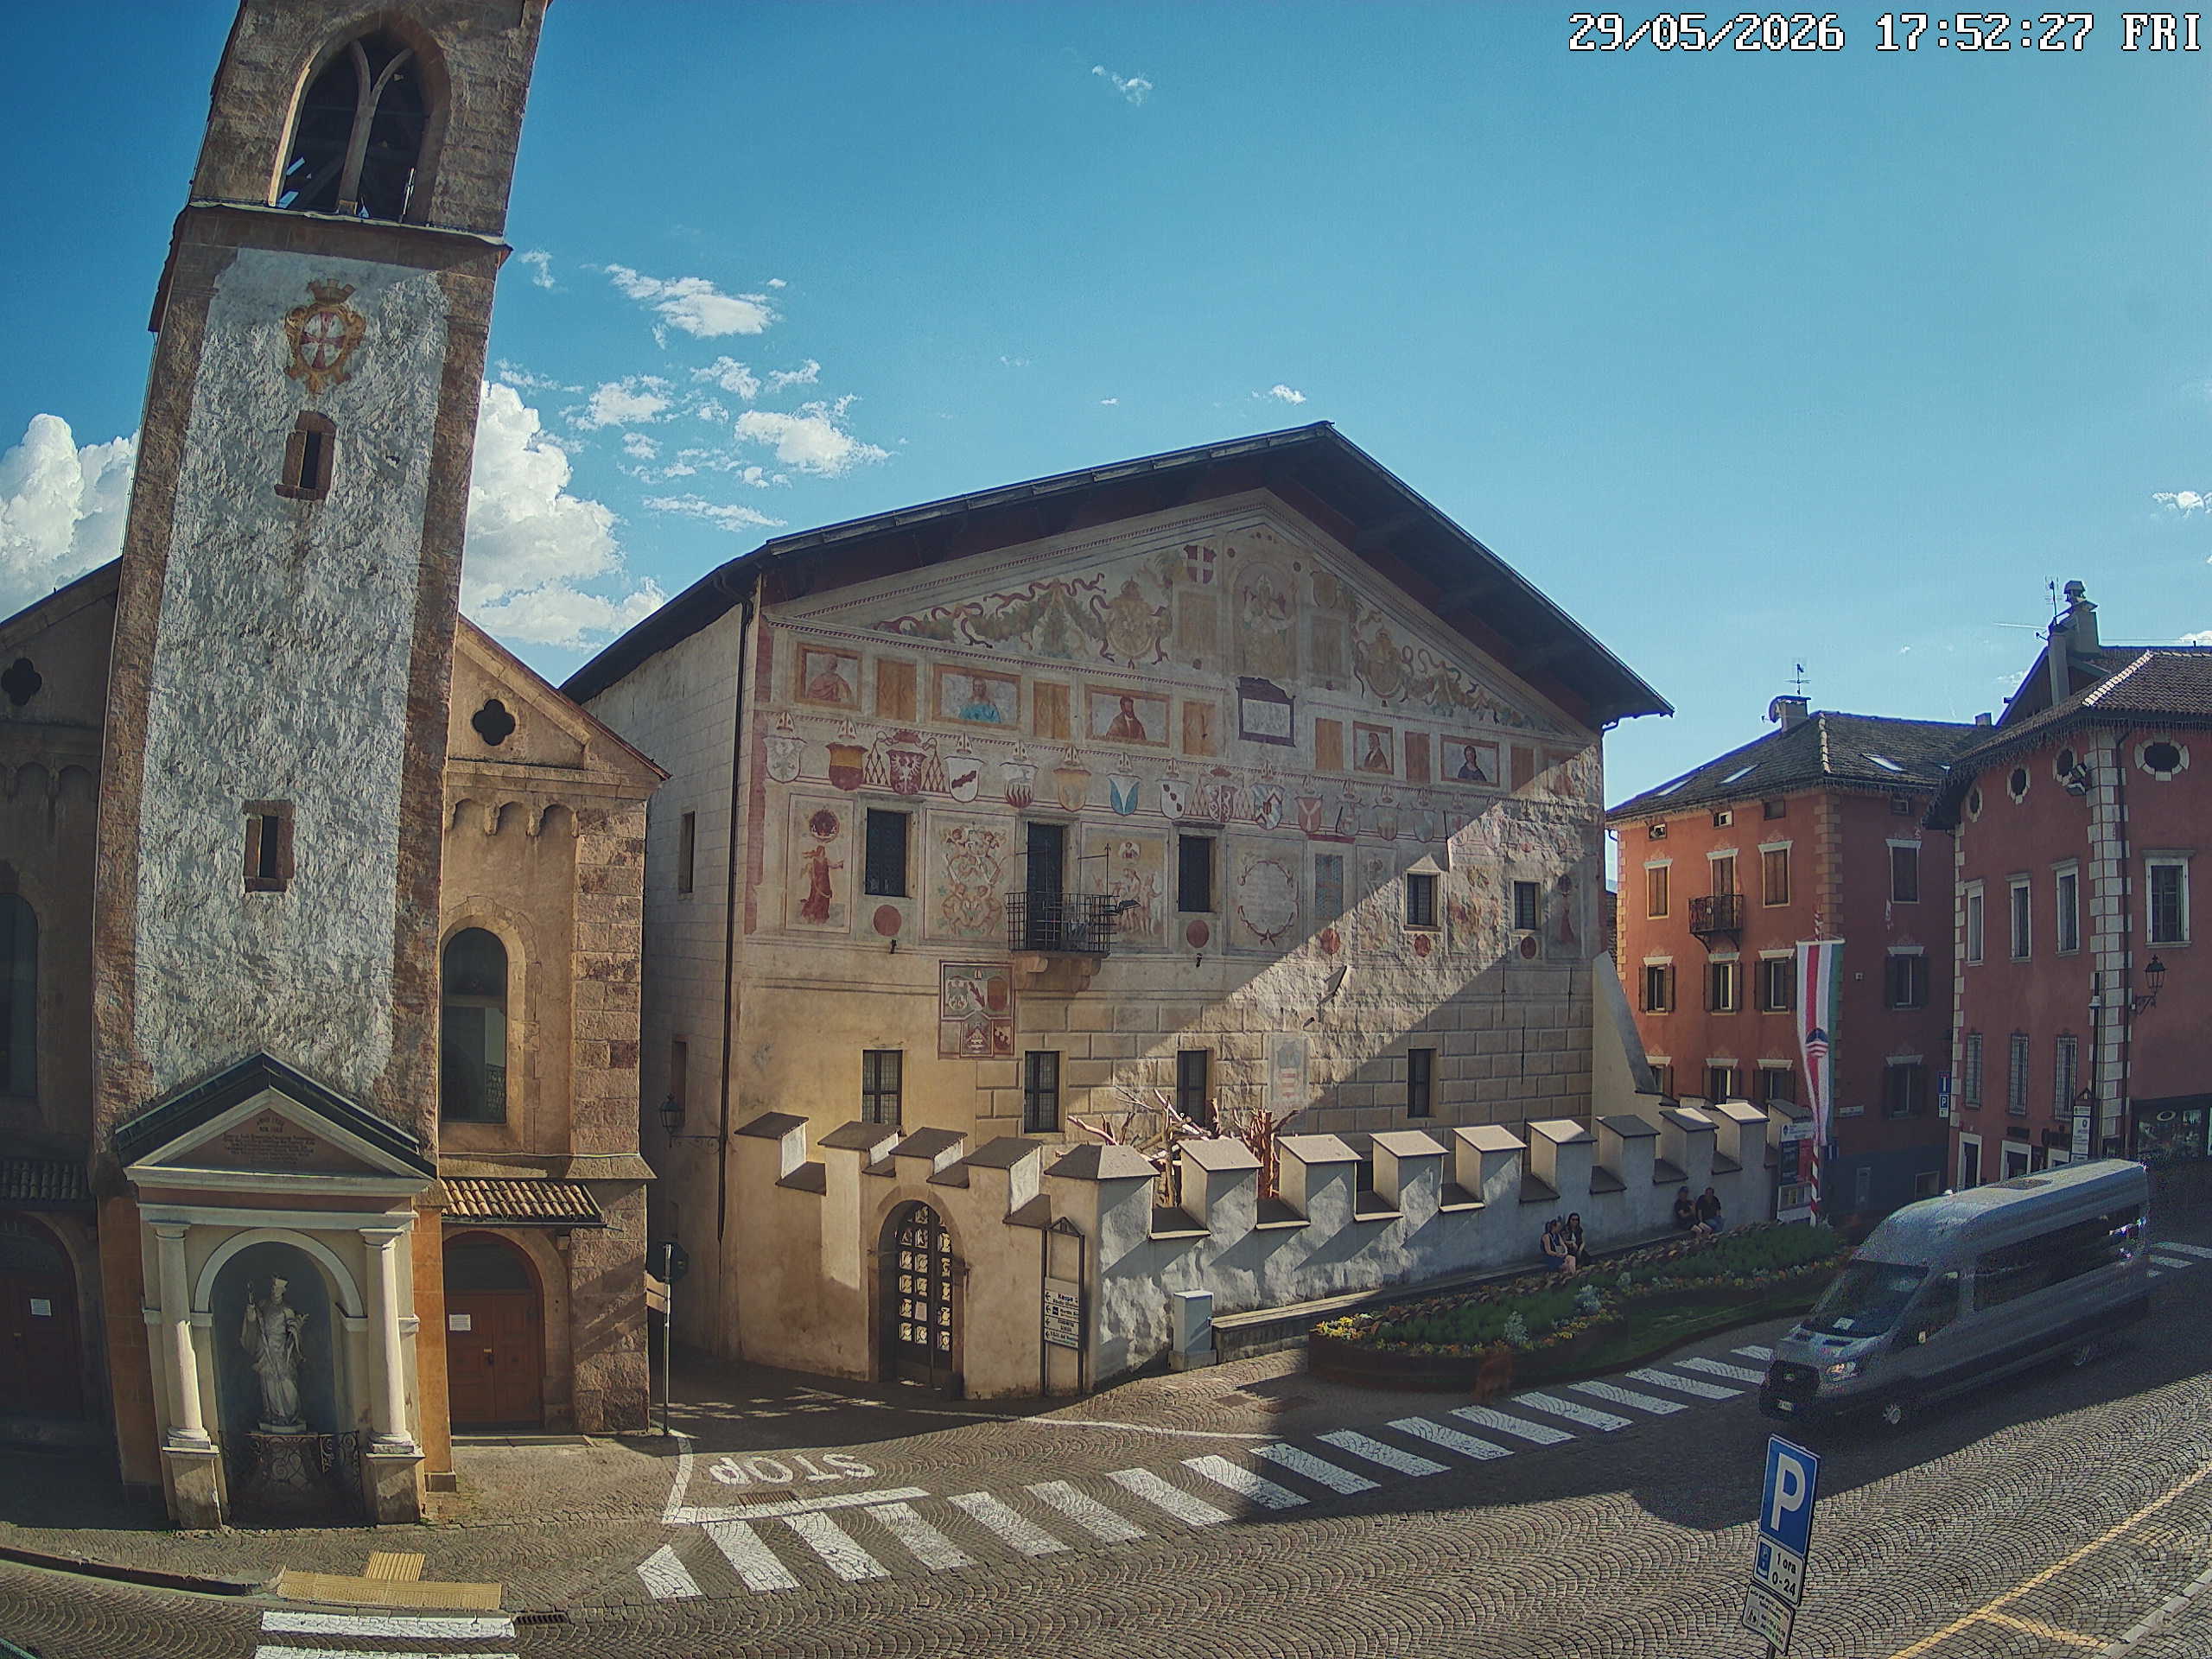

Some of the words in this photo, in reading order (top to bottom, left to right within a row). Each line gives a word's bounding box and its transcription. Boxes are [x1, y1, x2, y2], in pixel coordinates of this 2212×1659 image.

[709, 1452, 875, 1485] STOP
[1770, 1452, 1806, 1531] P
[1777, 1552, 1782, 1566] 1
[1783, 1558, 1796, 1574] ora
[1771, 1571, 1796, 1597] 0-24
